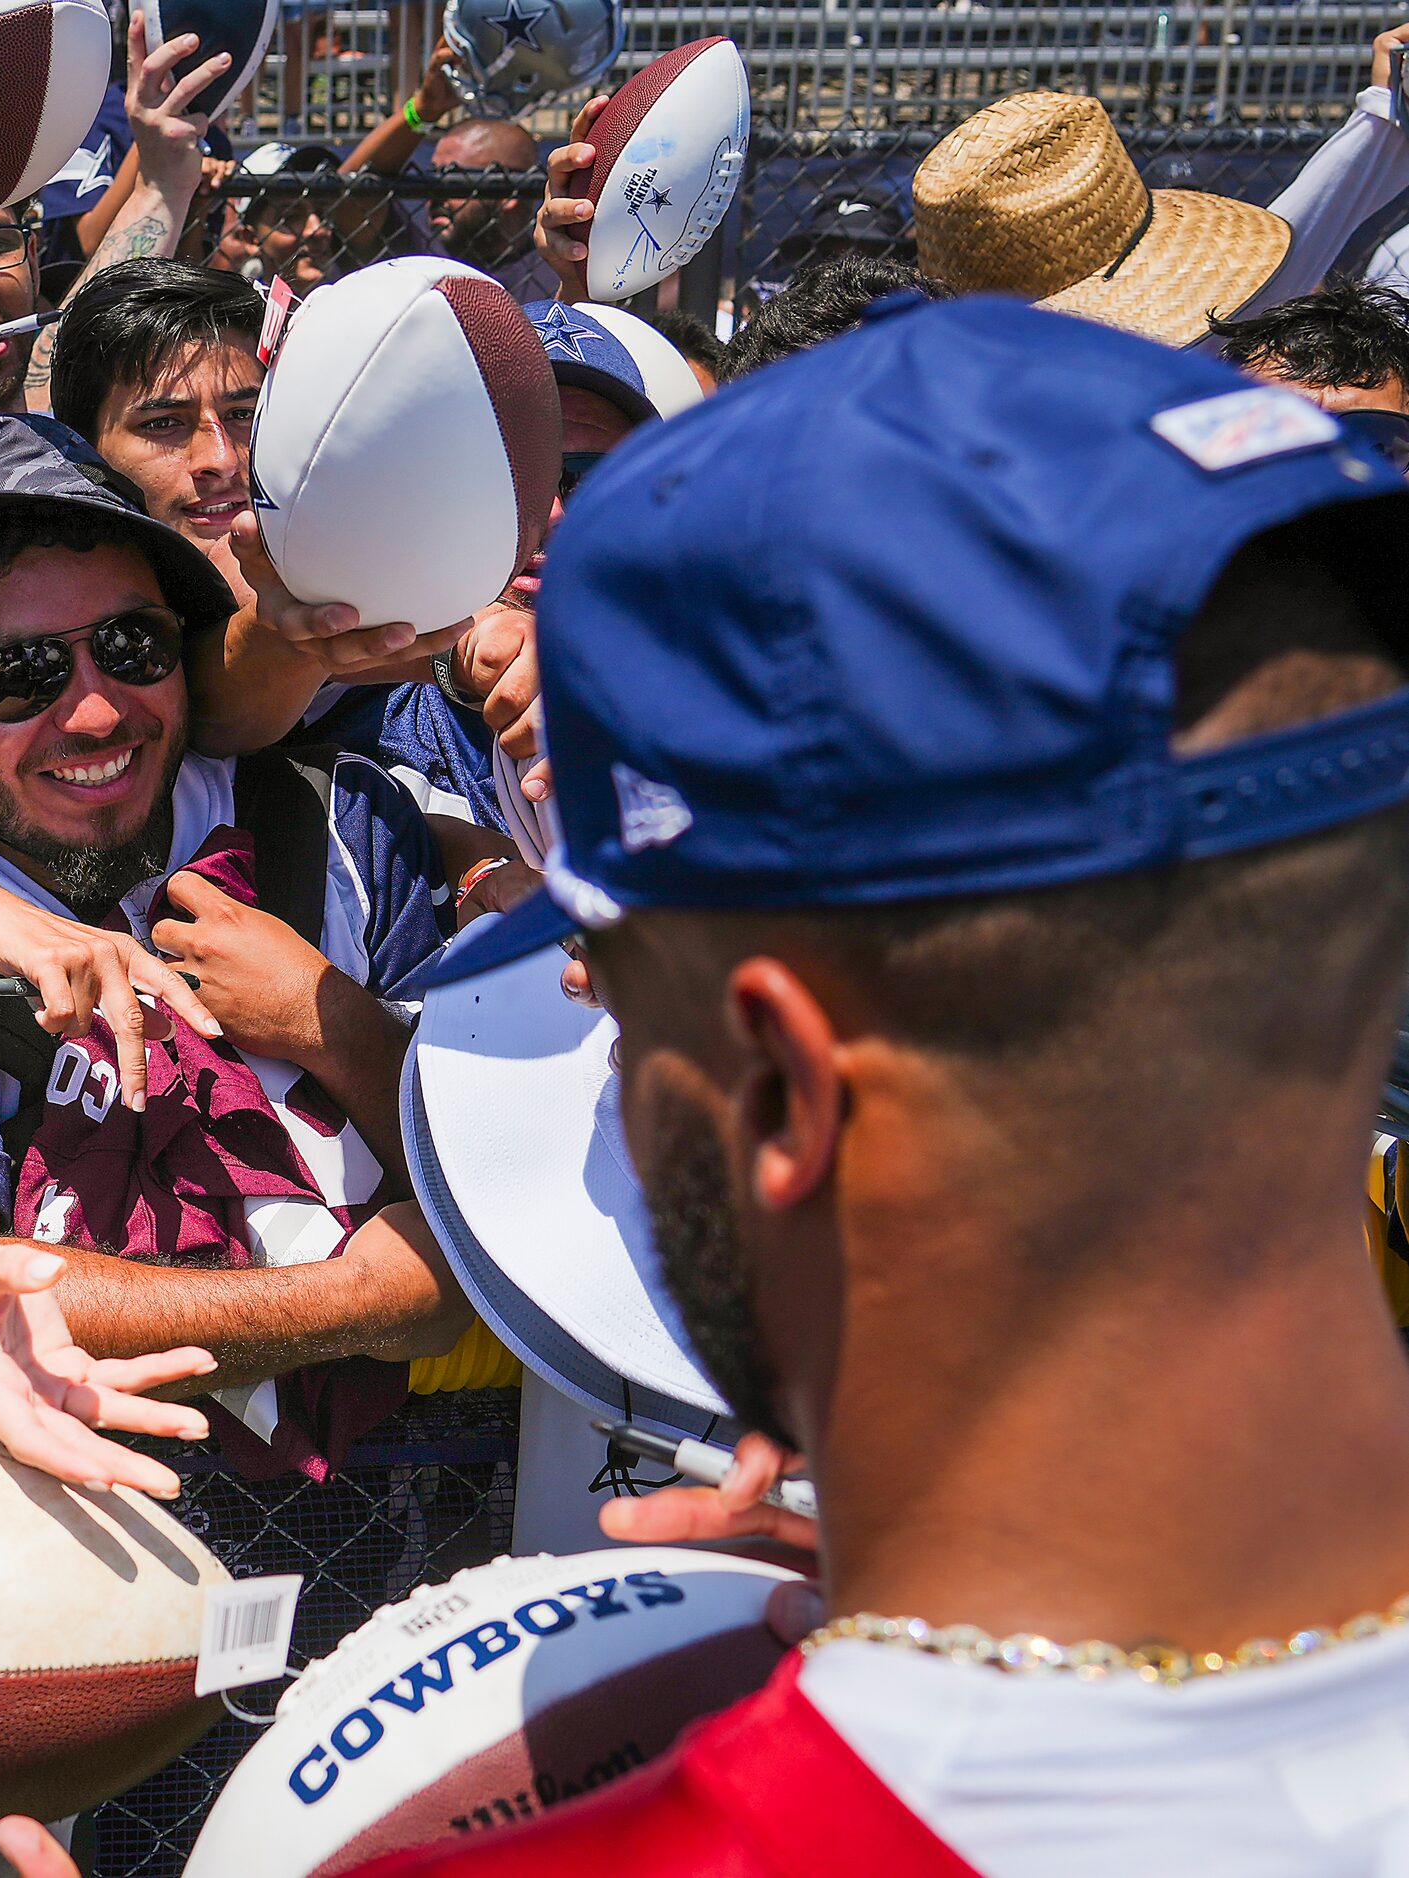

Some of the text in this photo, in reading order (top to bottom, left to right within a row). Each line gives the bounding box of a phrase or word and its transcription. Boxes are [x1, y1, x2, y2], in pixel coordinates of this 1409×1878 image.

[623, 172, 642, 202] CAMP
[627, 168, 658, 216] TRAINING
[288, 1570, 685, 1806] COWBOYS
